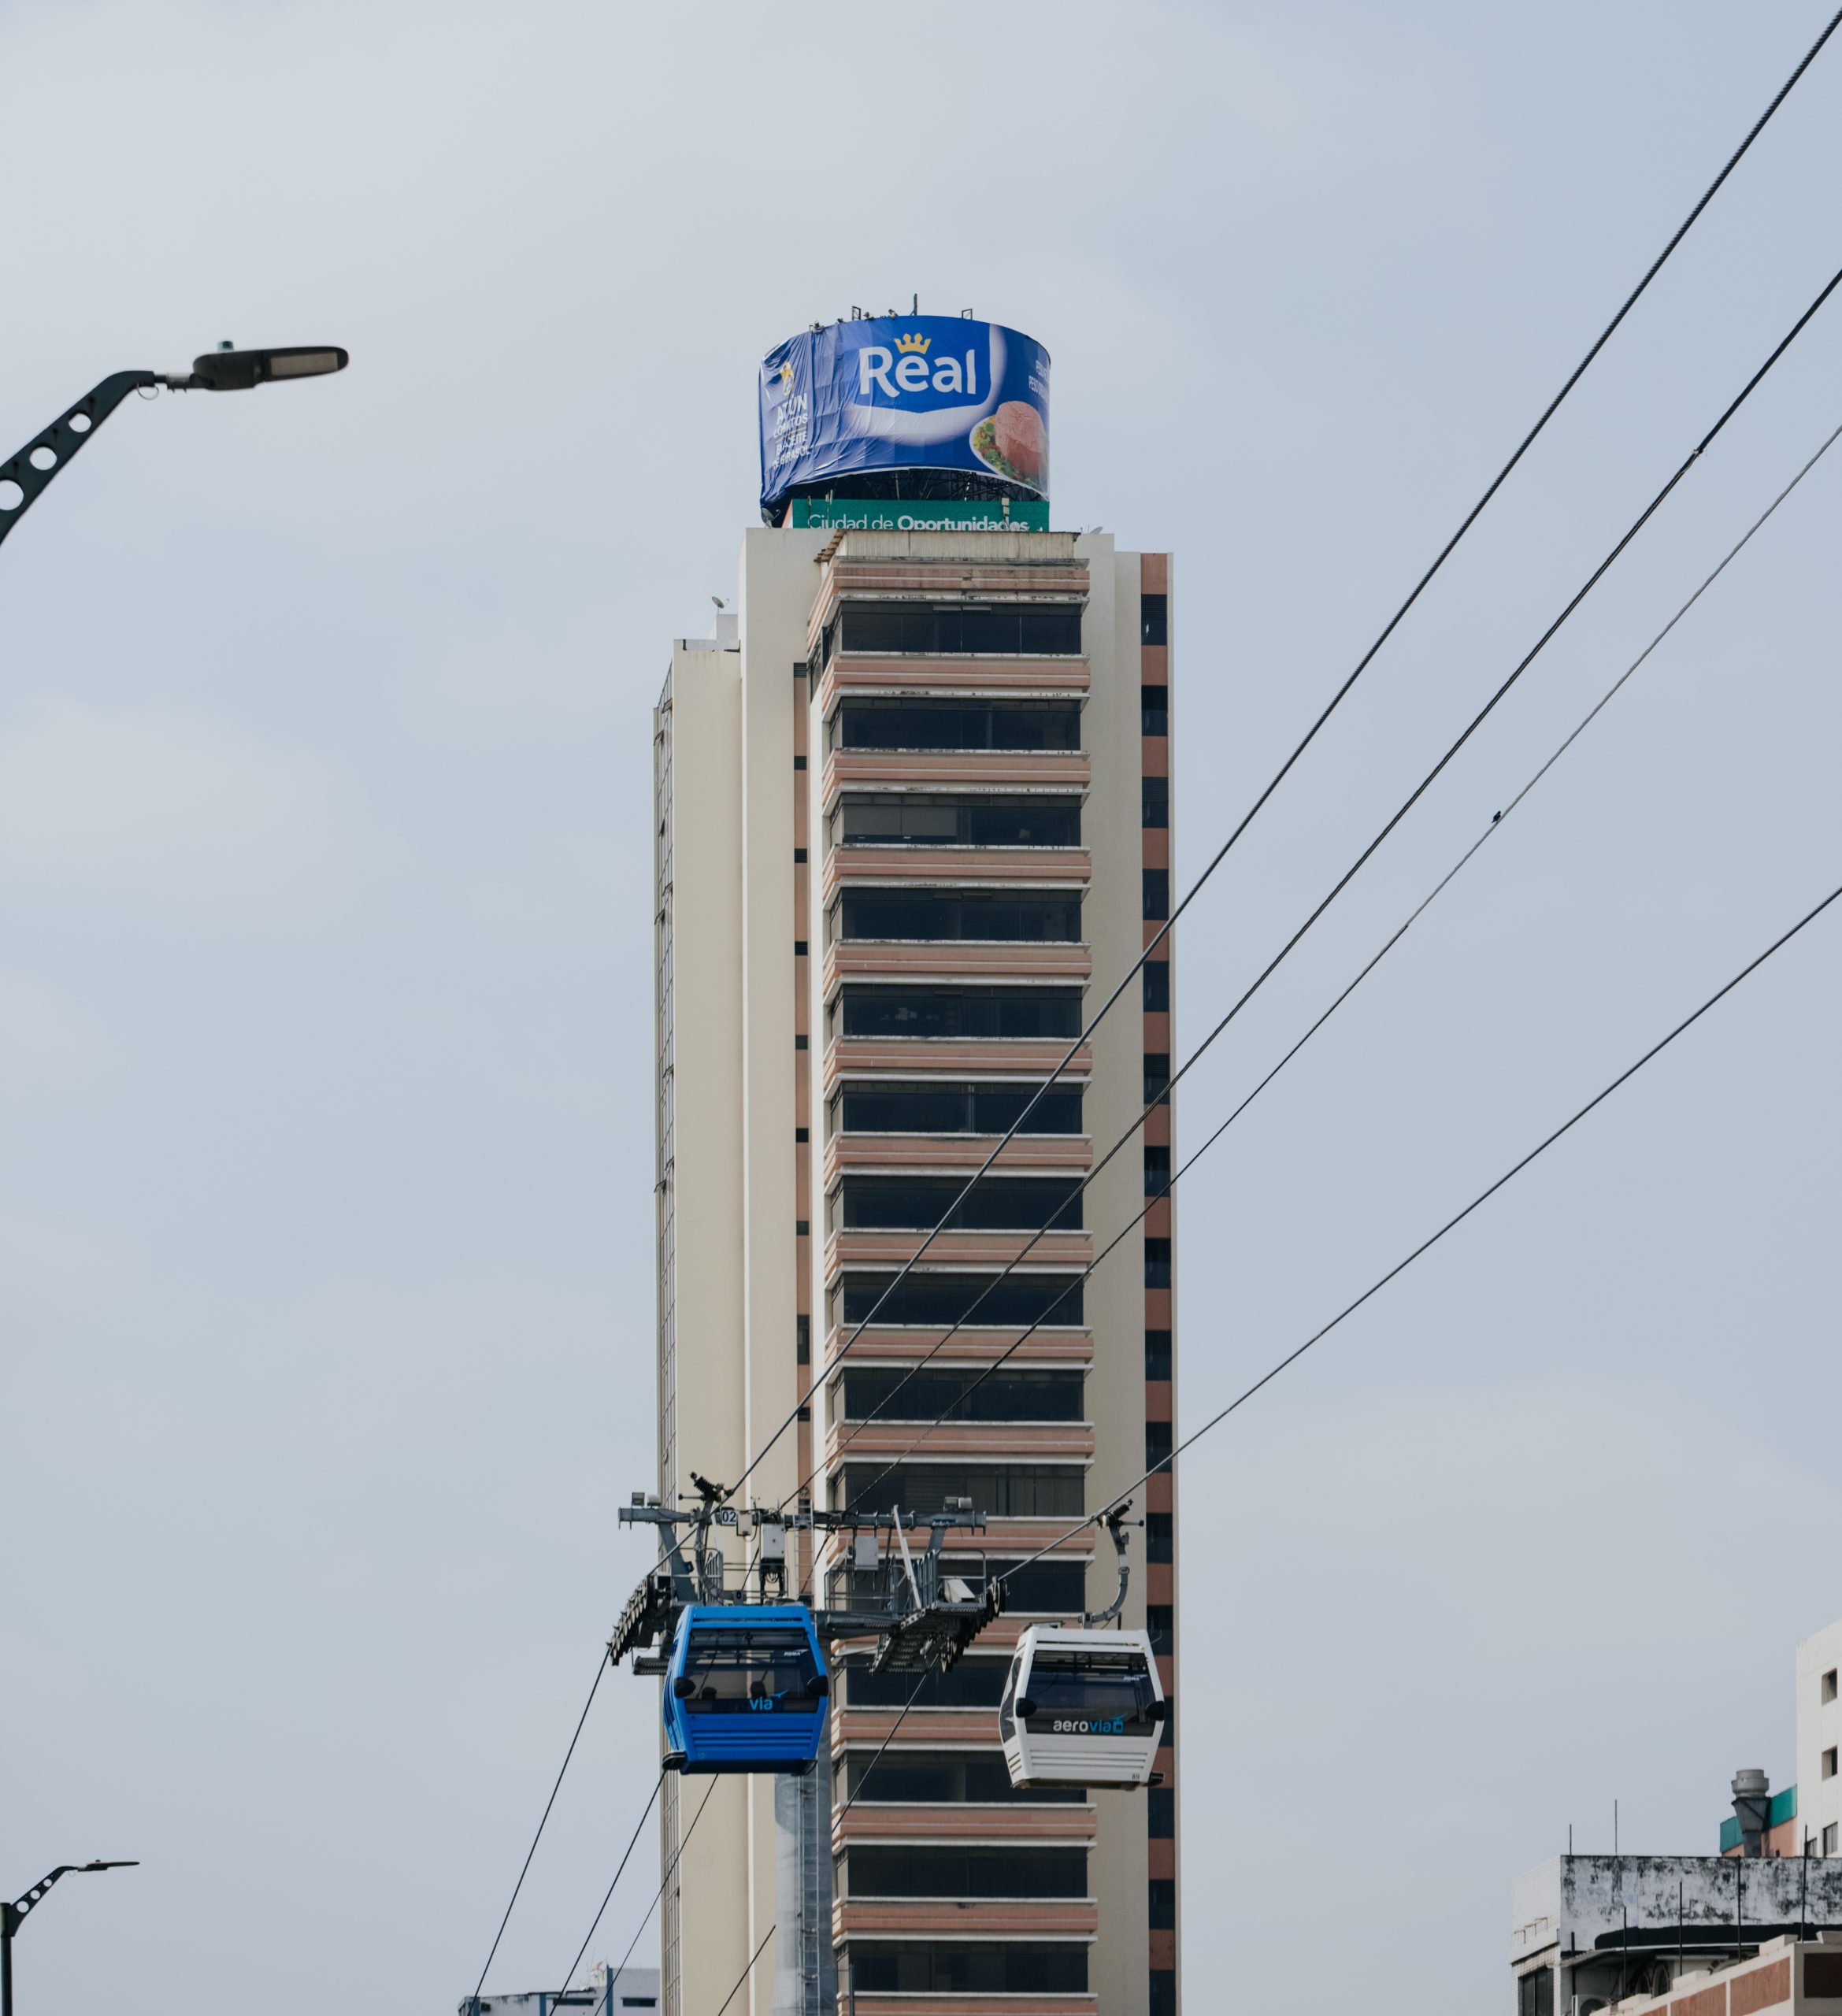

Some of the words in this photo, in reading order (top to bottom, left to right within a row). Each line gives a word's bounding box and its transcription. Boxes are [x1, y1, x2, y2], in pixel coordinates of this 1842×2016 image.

[858, 346, 977, 398] Real
[807, 513, 868, 530] Ciudad
[871, 513, 894, 530] de
[722, 1510, 737, 1523] 02
